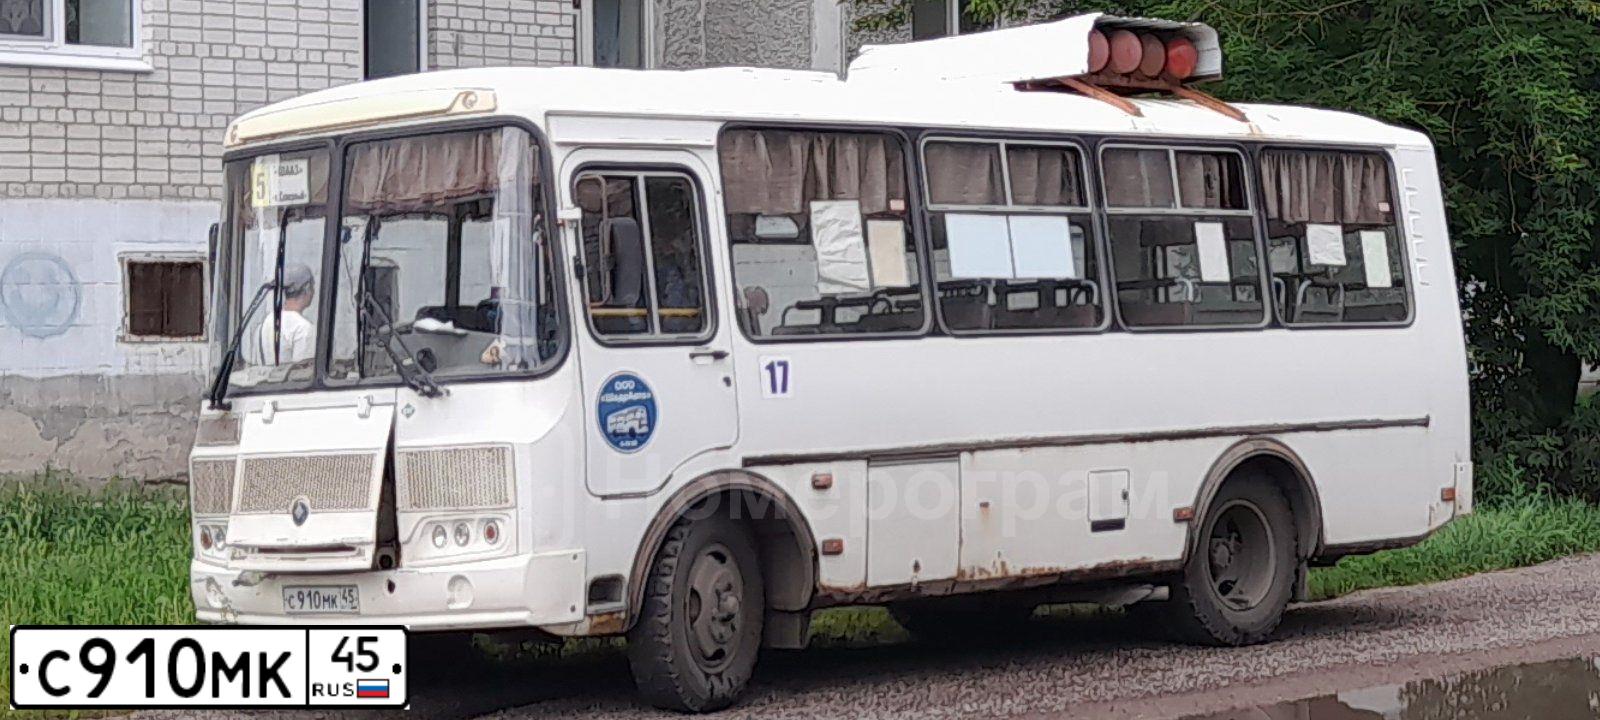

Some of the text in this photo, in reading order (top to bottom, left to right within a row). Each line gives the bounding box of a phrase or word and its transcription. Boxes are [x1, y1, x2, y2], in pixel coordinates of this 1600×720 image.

[256, 172, 266, 200] 5
[614, 380, 635, 391] ООО
[765, 360, 789, 394] 17
[287, 587, 355, 610] С910МК 45
